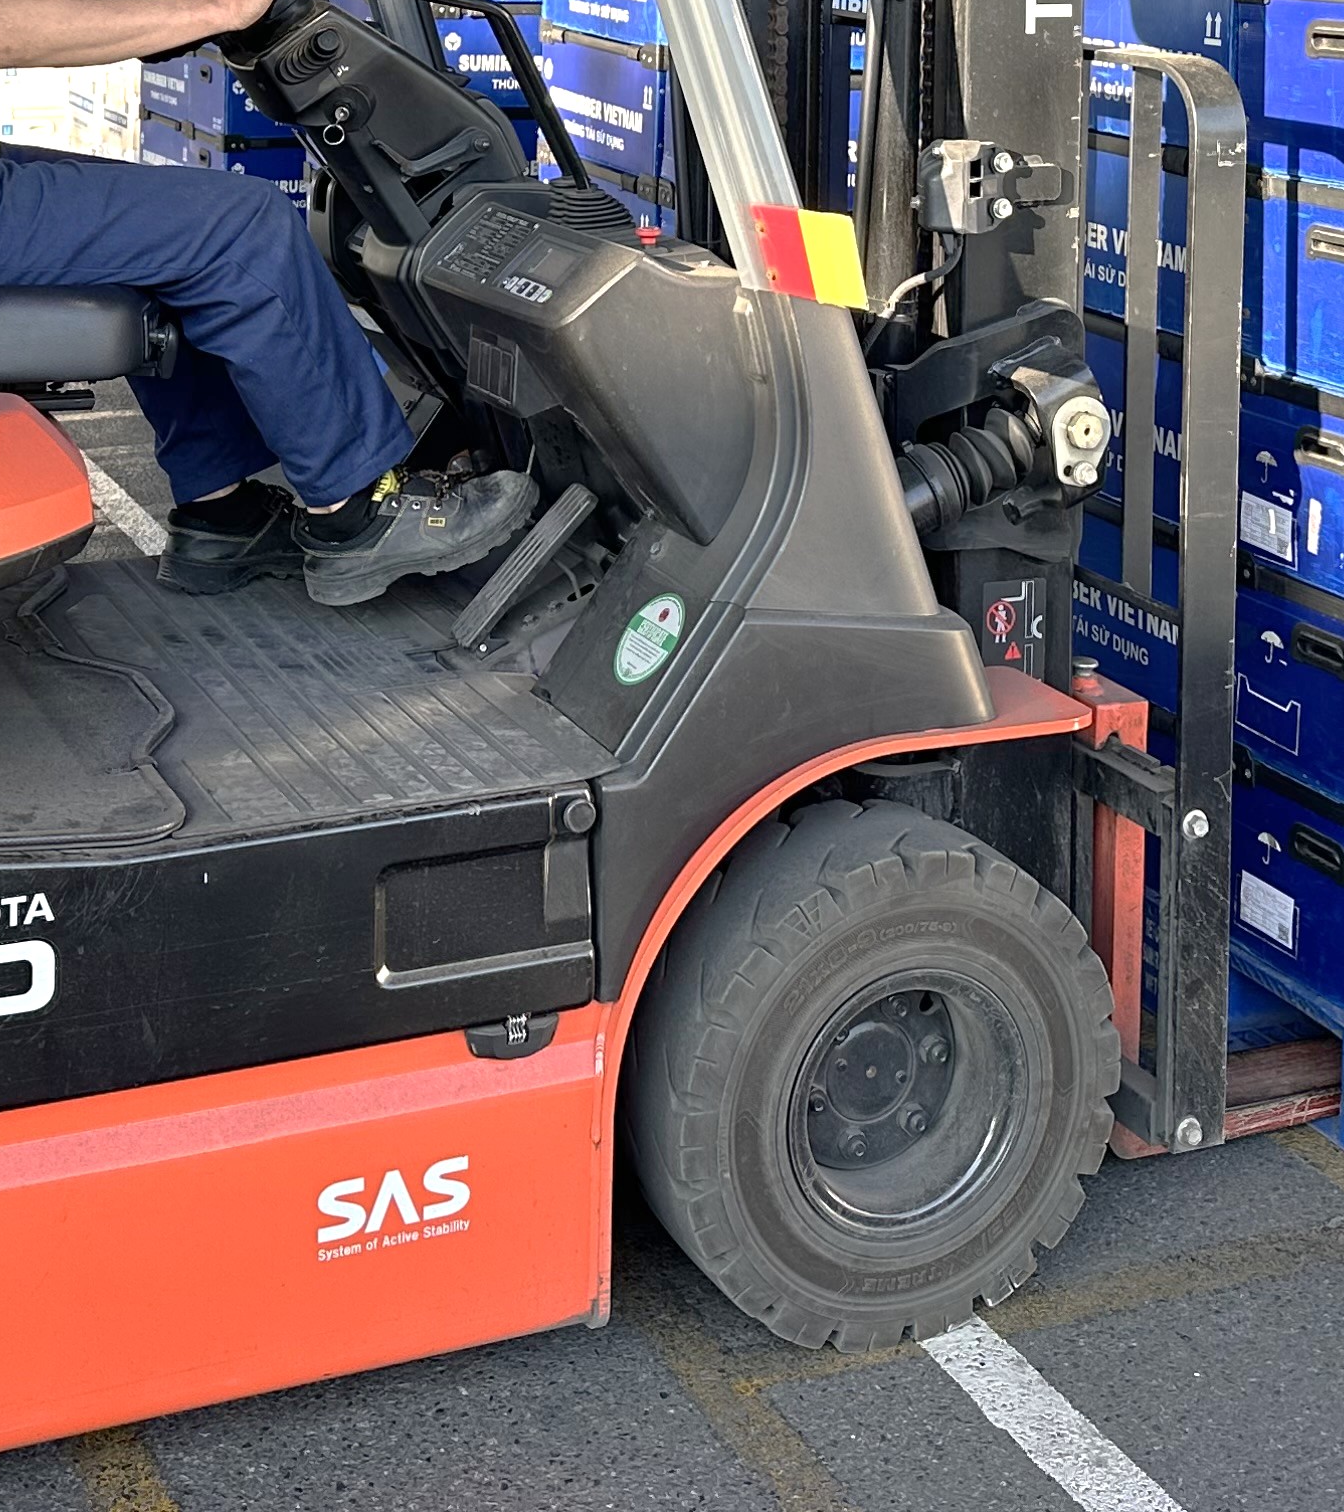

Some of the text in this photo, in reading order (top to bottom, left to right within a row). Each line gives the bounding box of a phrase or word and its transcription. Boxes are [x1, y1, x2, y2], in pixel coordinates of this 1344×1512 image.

[1112, 633, 1149, 666] DỤNG
[317, 1155, 471, 1245] SAS
[317, 1220, 471, 1262] System of Active Stability
